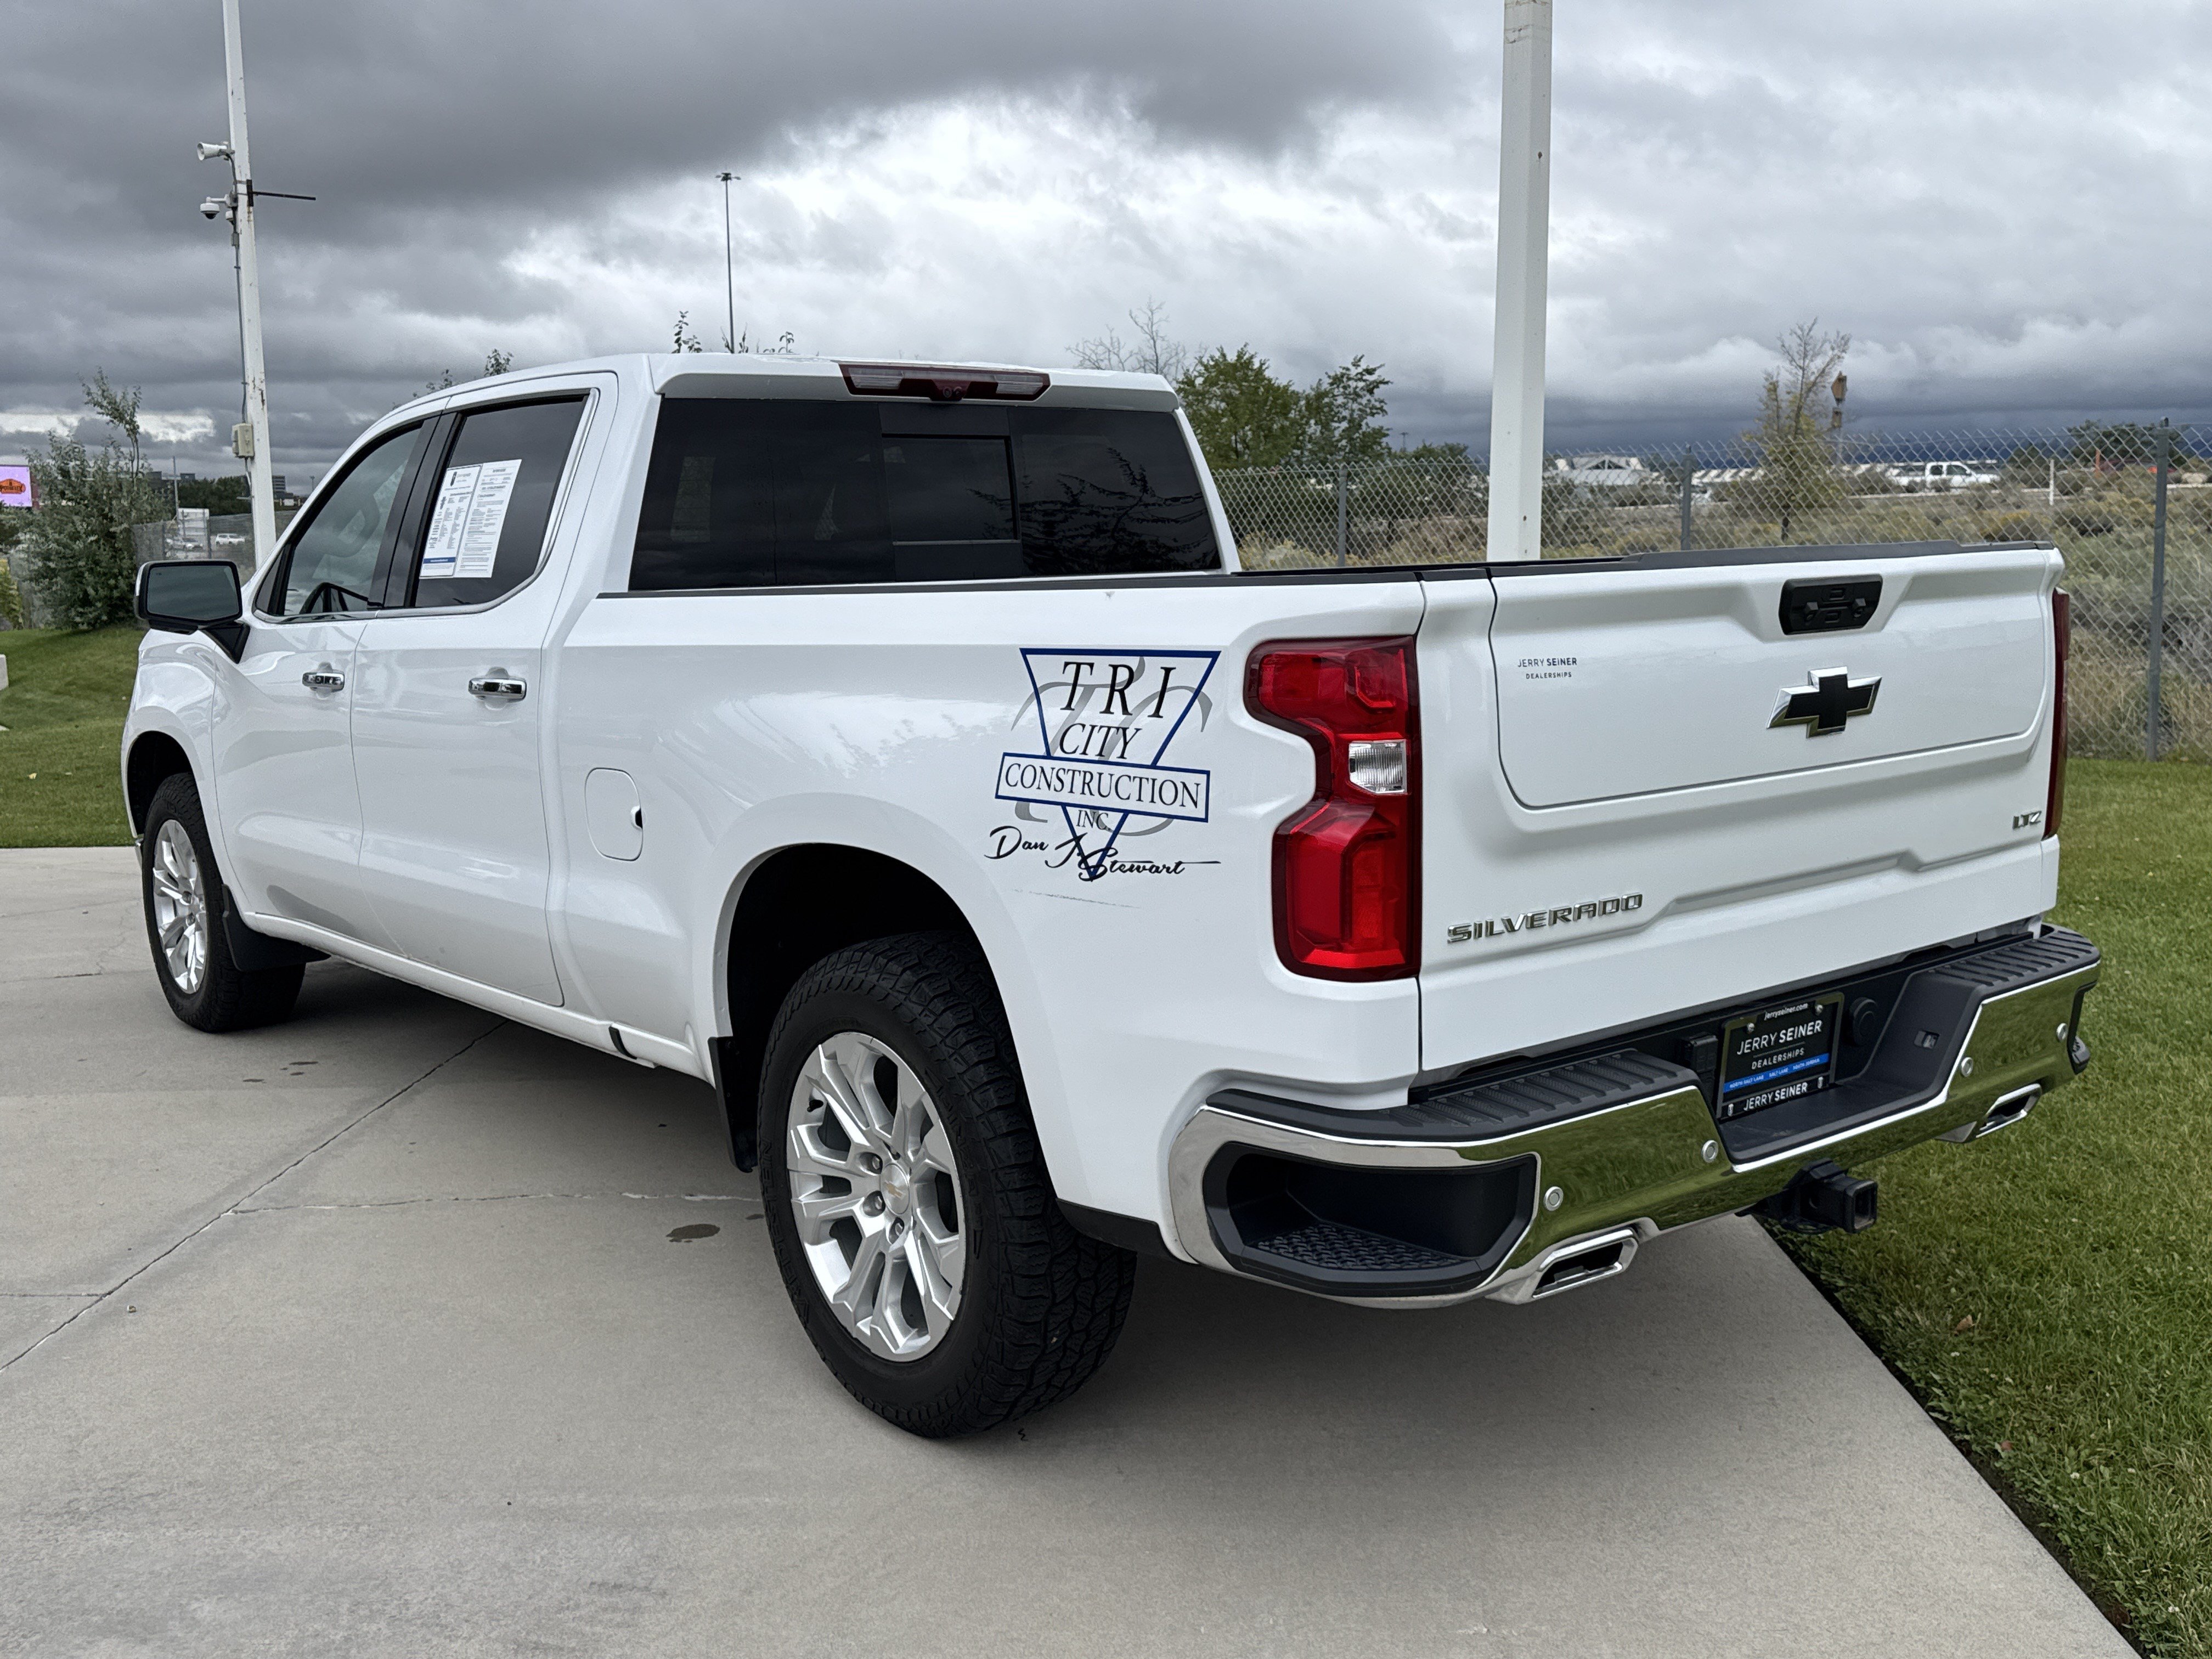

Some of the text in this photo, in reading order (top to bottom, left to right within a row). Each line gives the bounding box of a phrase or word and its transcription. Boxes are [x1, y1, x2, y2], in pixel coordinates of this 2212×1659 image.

[1517, 657, 1577, 667] JERRY SEINER
[1060, 661, 1177, 719] TRI
[1059, 723, 1143, 759] CITY
[1005, 763, 1201, 809] CONSTRUCTION
[1076, 809, 1111, 831] INC.
[984, 826, 1048, 860] Dan
[1077, 847, 1222, 882] Stewart
[1447, 892, 1643, 944] SILVERADO
[1736, 1020, 1823, 1056] JERRY SEINER
[1751, 1047, 1805, 1070] DEALERSHIPS
[1743, 1082, 1808, 1111] JERRY SEINER
